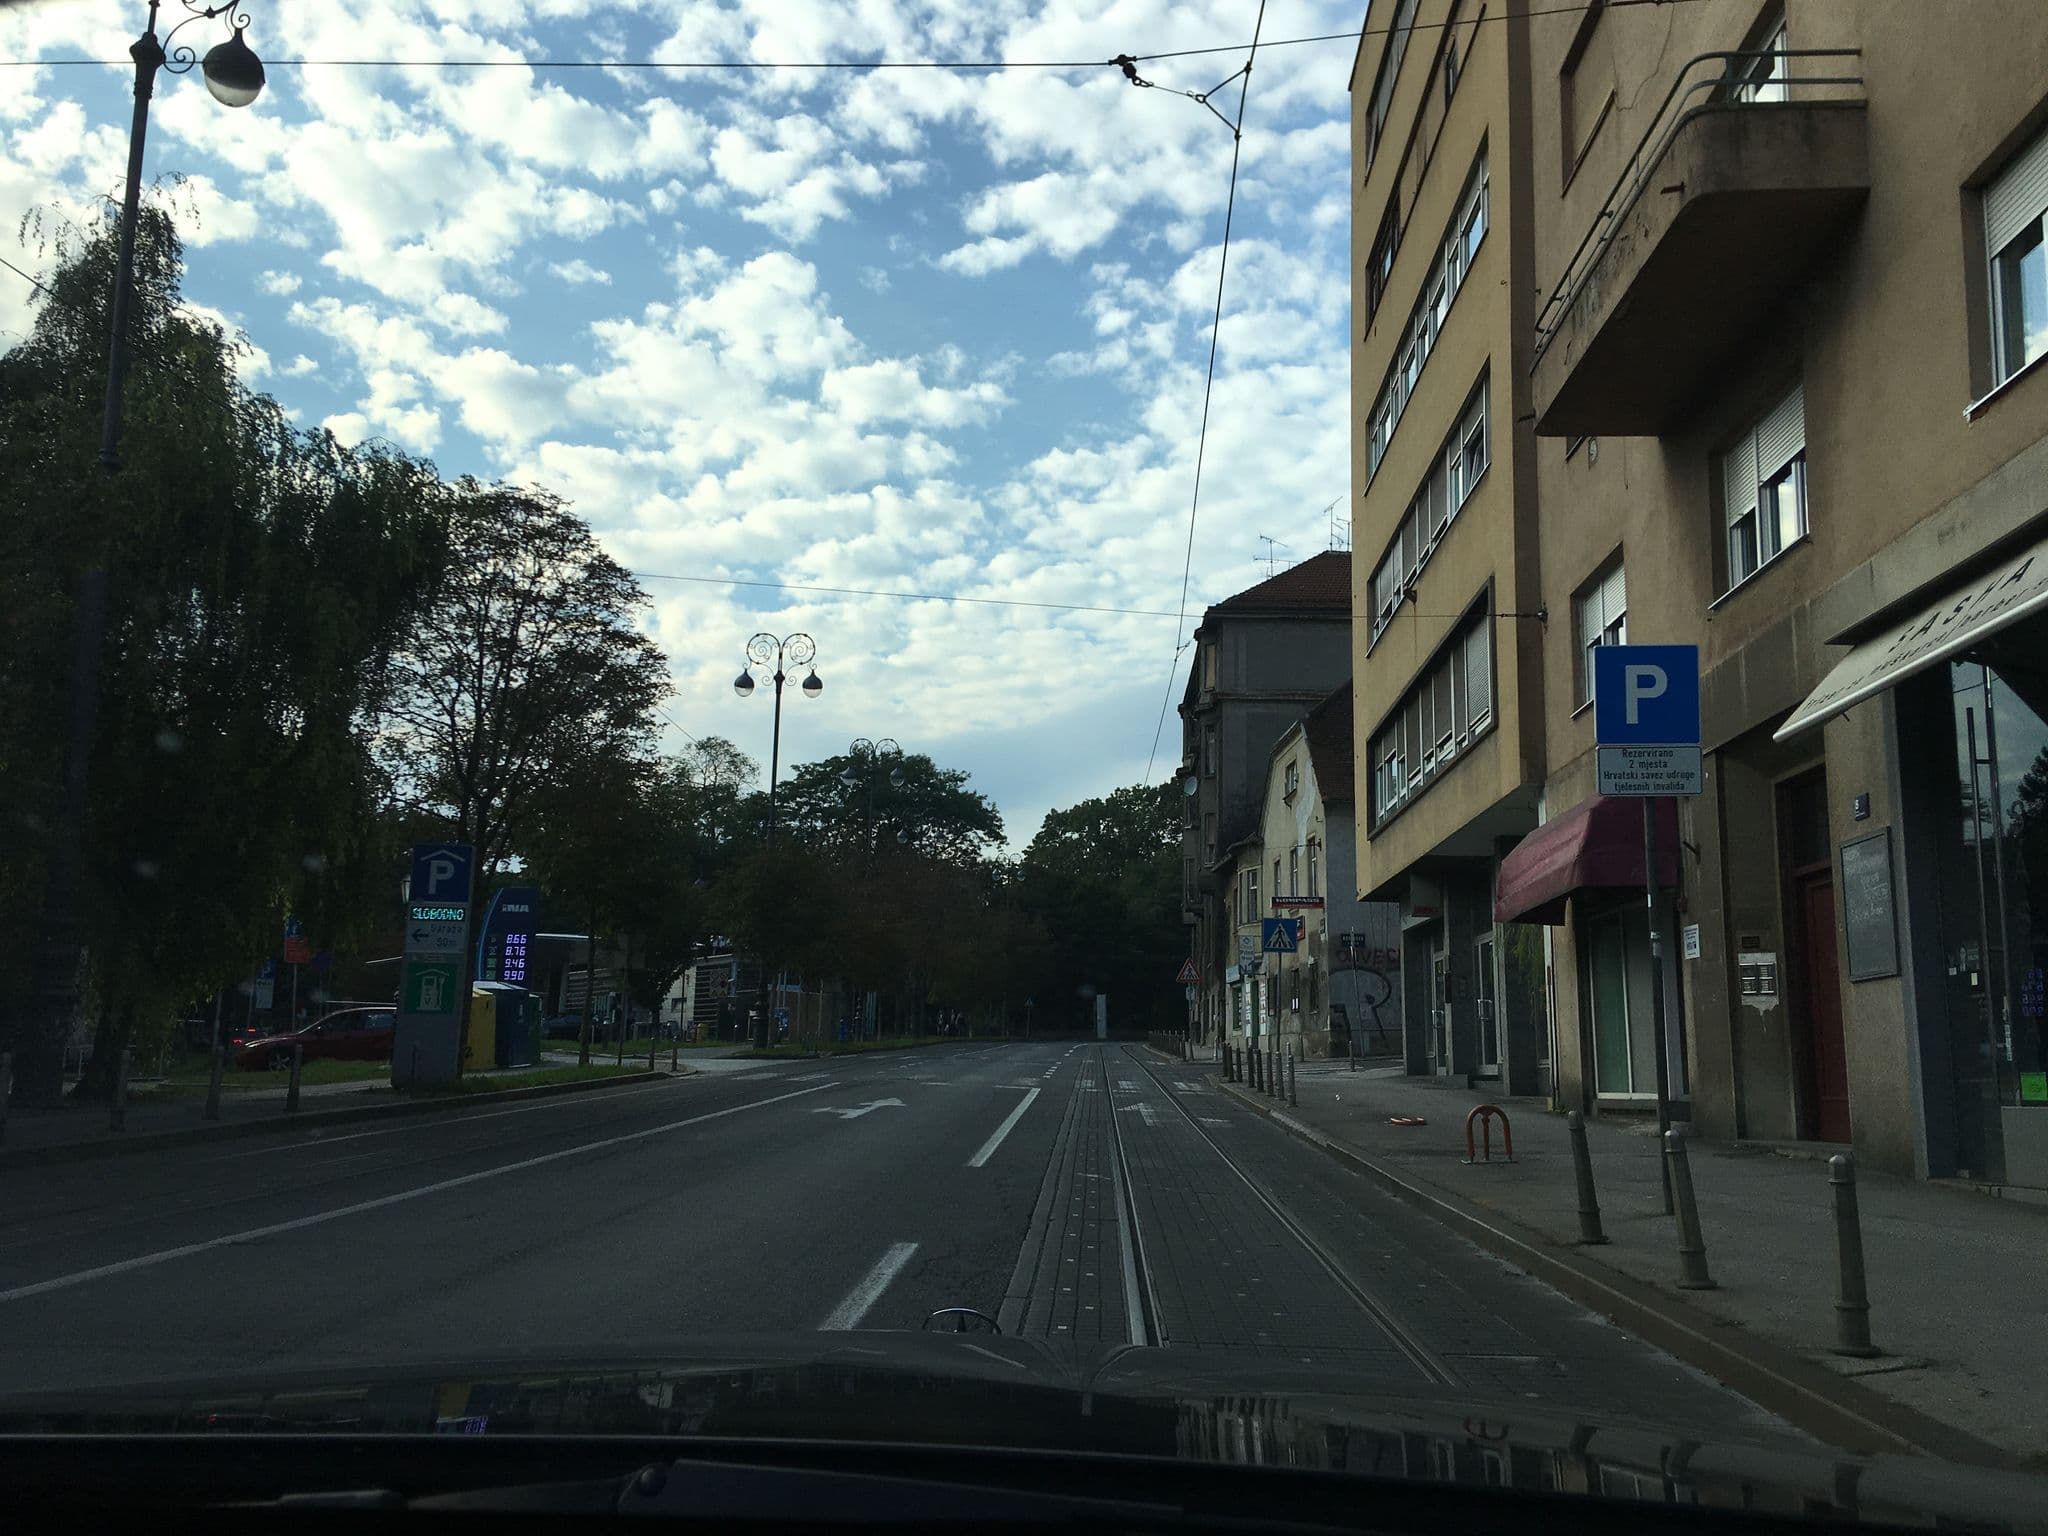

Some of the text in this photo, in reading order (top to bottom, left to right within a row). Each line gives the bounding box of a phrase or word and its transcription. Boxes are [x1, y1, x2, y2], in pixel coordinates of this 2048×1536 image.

[1624, 664, 1669, 725] P
[1621, 748, 1674, 758] Rezervirano
[1628, 759, 1669, 770] 2 mjesta
[1603, 770, 1639, 780] Hrvatski
[1640, 771, 1664, 780] savez
[1613, 781, 1685, 793] tjelesnih invalida
[427, 859, 455, 895] P
[412, 907, 465, 921] SLOBODNO
[505, 946, 527, 956] 8.76
[504, 958, 526, 969] 9.46
